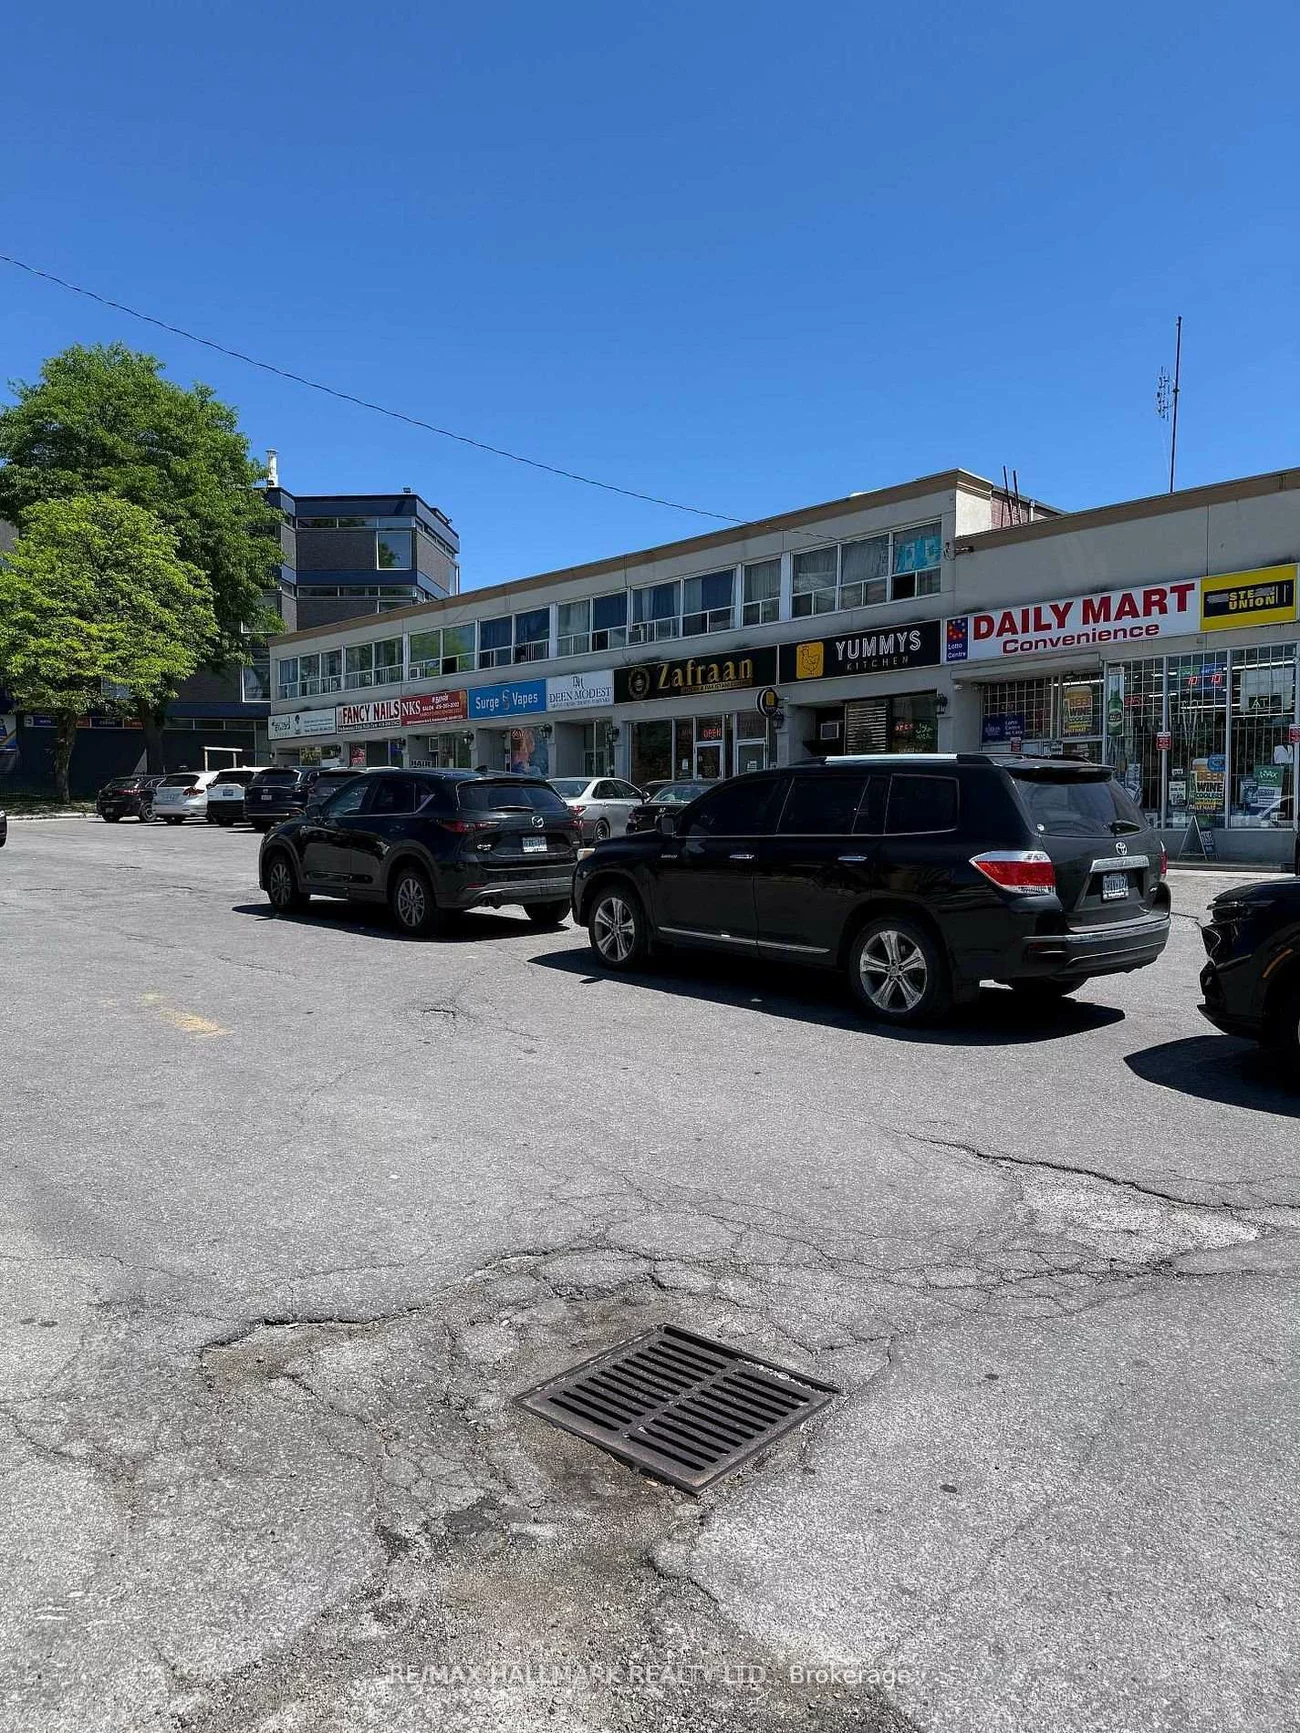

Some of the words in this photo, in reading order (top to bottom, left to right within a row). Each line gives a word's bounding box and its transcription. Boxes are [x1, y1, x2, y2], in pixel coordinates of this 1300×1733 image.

[974, 601, 1074, 641] DAILY
[1082, 583, 1195, 625] MART
[1228, 595, 1275, 610] UNION
[835, 630, 922, 661] YUMMYS
[1002, 624, 1159, 654] Convenience
[846, 656, 910, 671] KITCHEN
[656, 658, 755, 690] Zafraan
[475, 695, 499, 711] Surge
[512, 691, 538, 708] Vapes
[549, 692, 573, 703] DEEN
[574, 687, 612, 702] MODEST
[342, 703, 371, 725] FANCY
[373, 700, 400, 720] NAILS
[703, 728, 722, 738] OPEN
[1197, 782, 1224, 793] WINE
